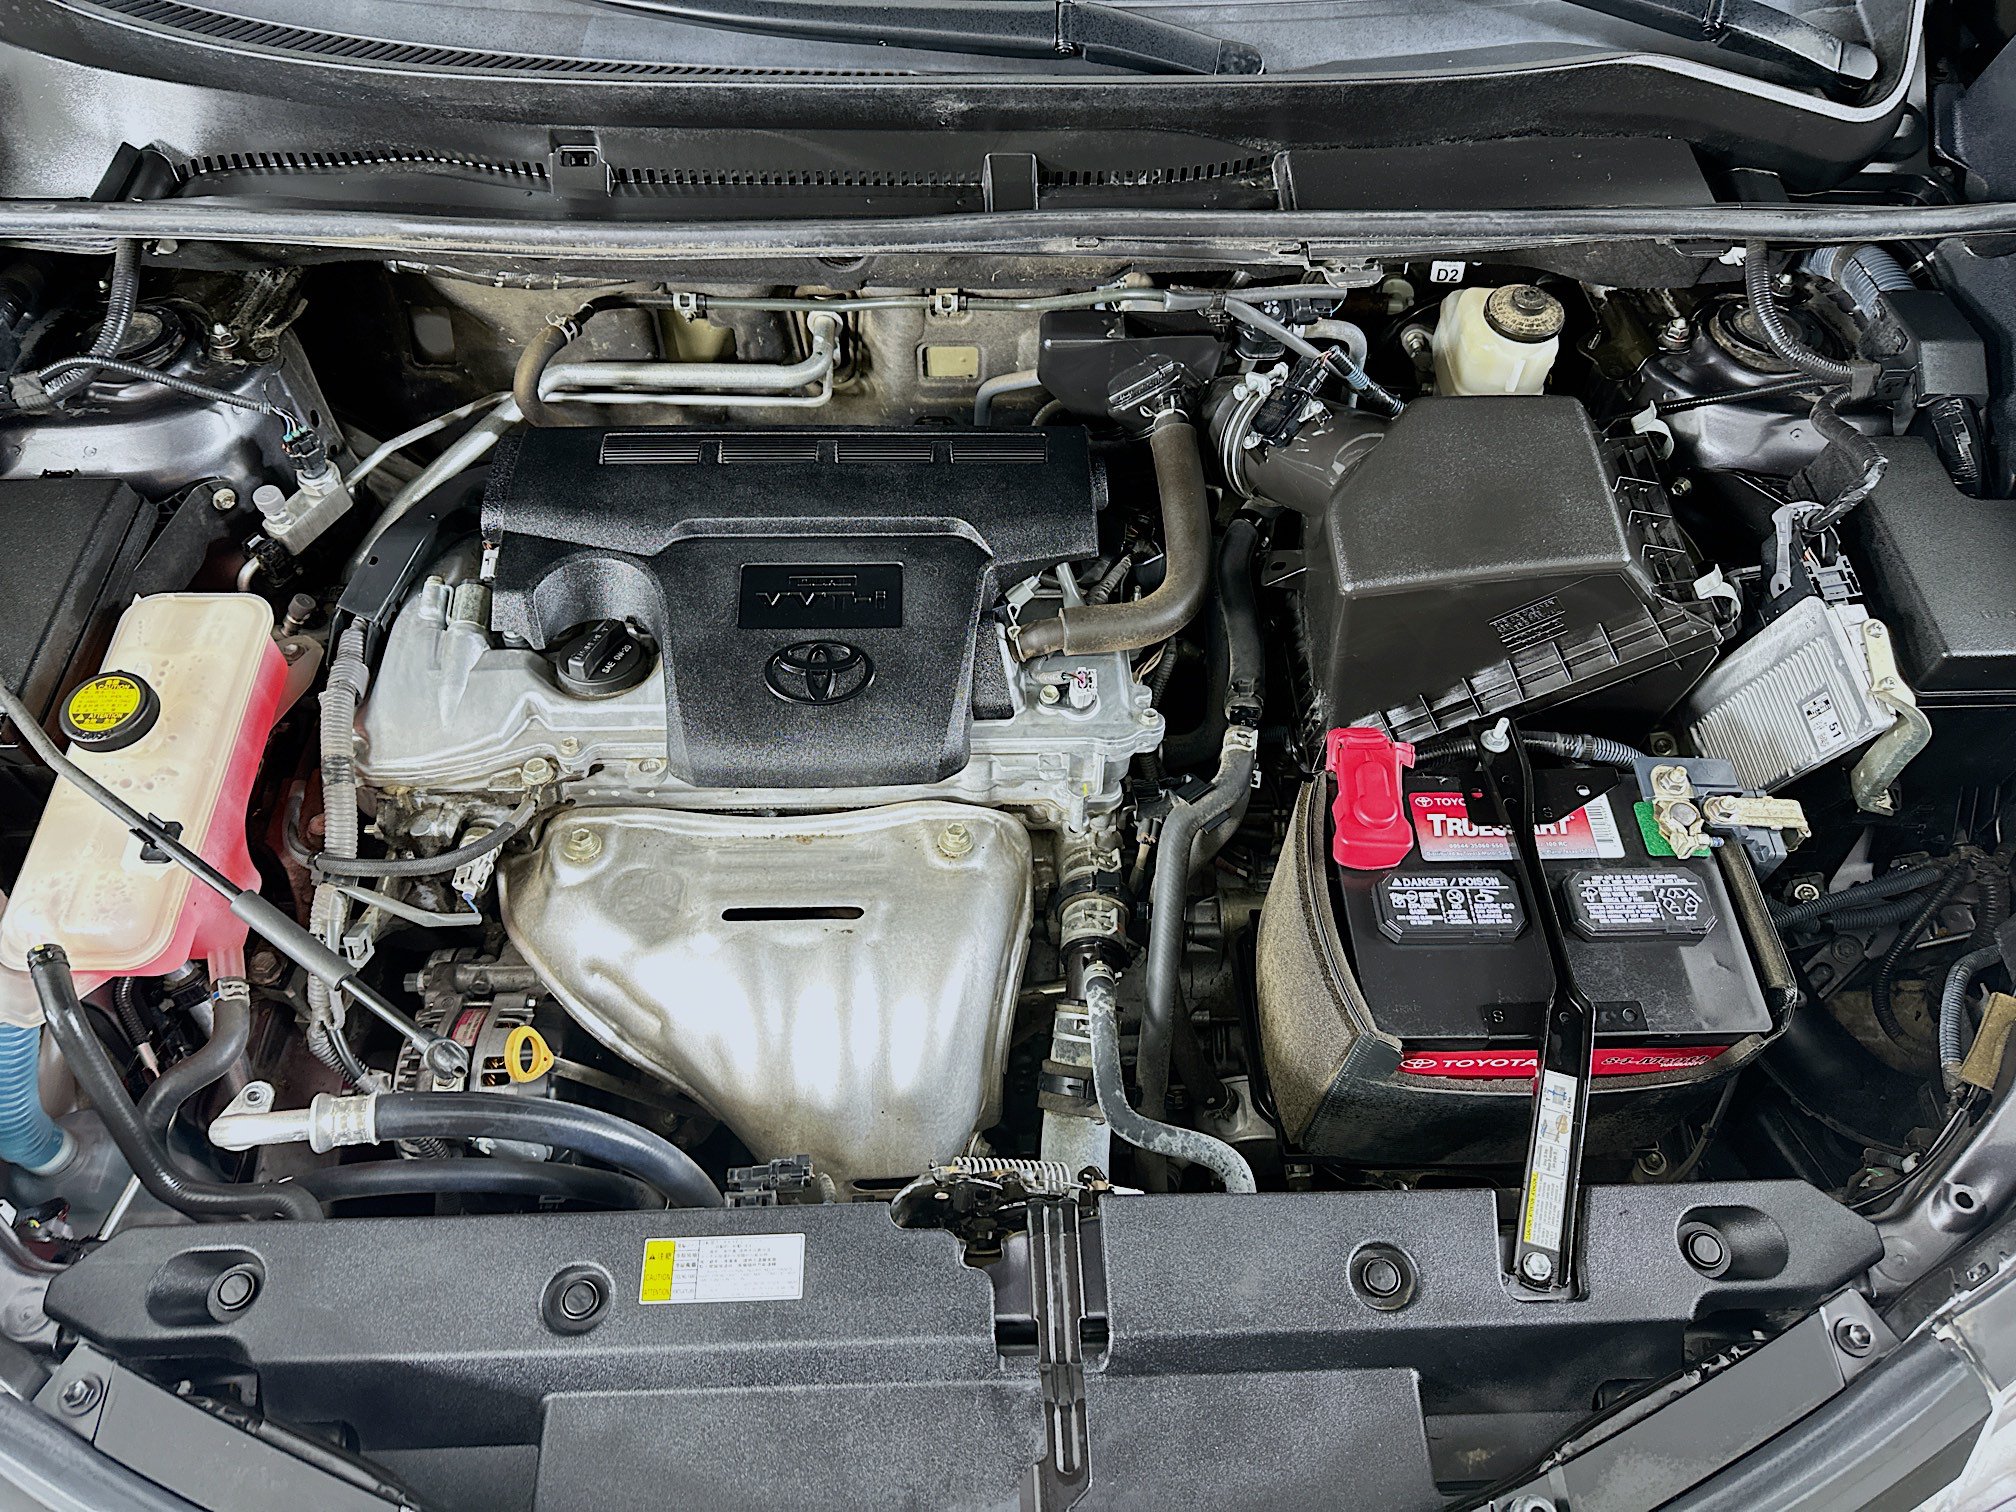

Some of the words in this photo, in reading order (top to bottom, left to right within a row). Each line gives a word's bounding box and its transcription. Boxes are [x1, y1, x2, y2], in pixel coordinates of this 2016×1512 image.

[1436, 268, 1459, 282] D2
[601, 661, 616, 675] SAE
[1829, 721, 1842, 738] 51
[1433, 797, 1466, 807] TOYO
[1402, 877, 1447, 887] DANGER
[1458, 877, 1500, 886] POISON
[1441, 1058, 1538, 1068] TOYOTA
[645, 1273, 671, 1281] CAUTION
[643, 1288, 670, 1296] ATTENTION
